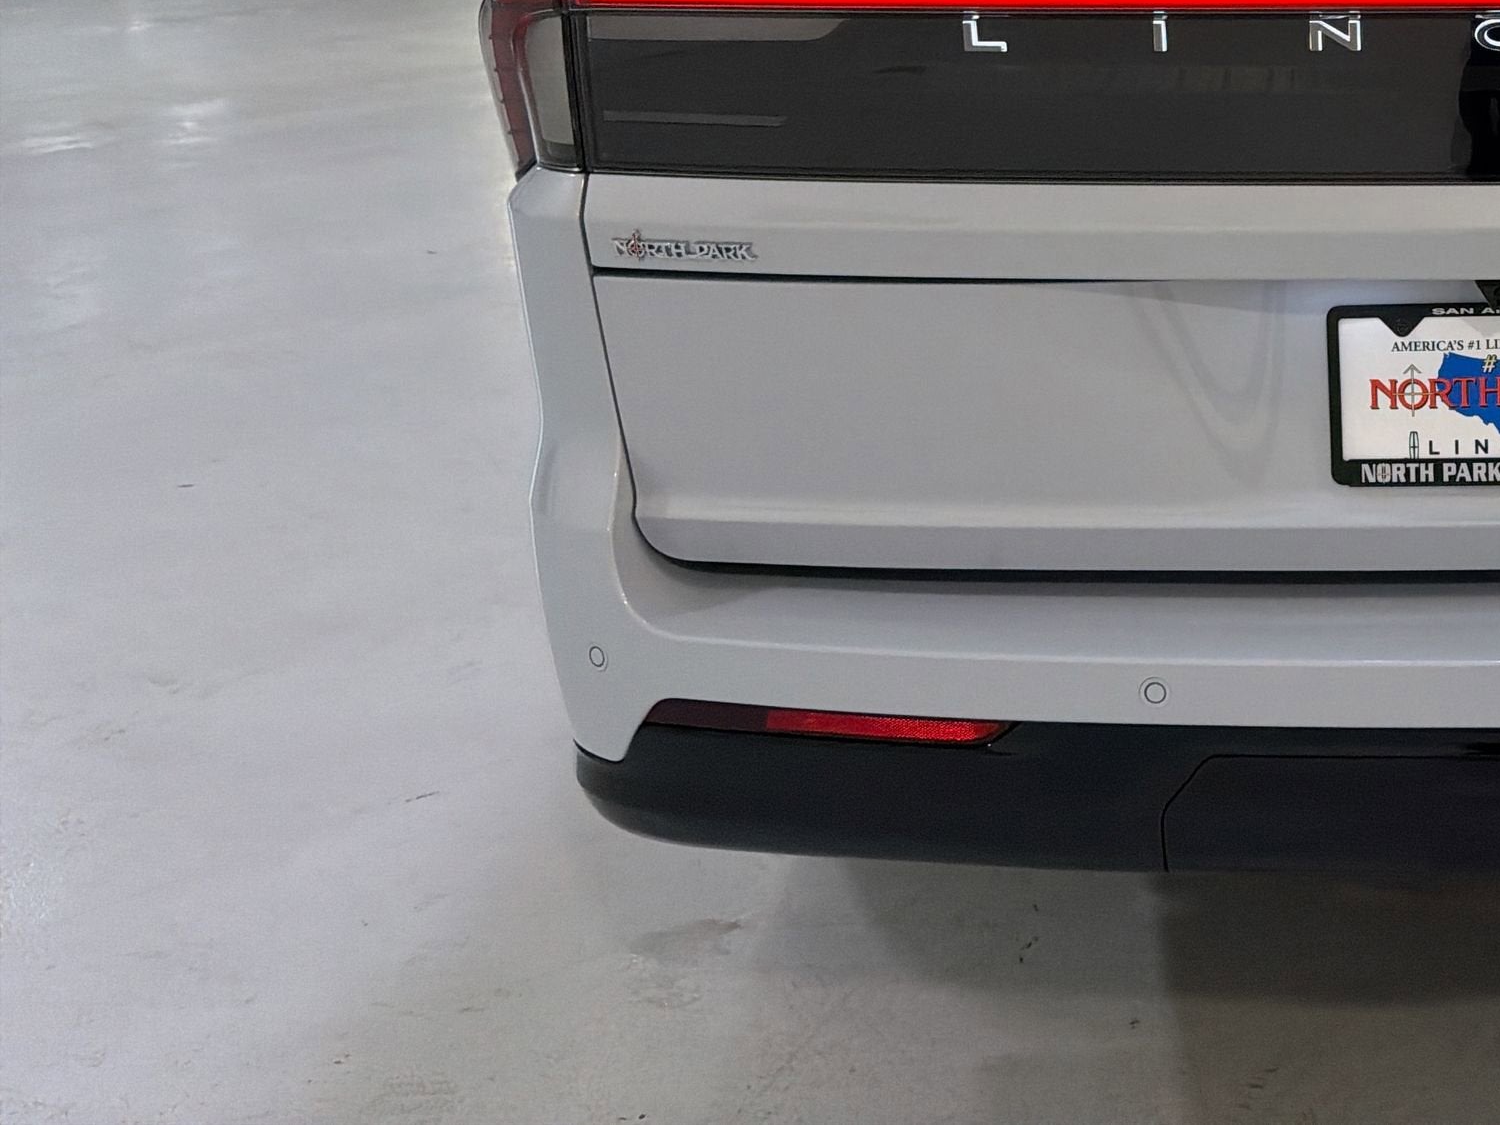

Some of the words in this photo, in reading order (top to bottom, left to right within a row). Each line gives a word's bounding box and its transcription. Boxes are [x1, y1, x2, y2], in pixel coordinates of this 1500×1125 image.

[612, 237, 688, 259] NORTH
[692, 241, 758, 261] PARK
[1431, 306, 1475, 316] SAN
[1391, 339, 1465, 353] AMERICA'S
[1467, 339, 1482, 350] #1
[1361, 462, 1435, 484] NORTH
